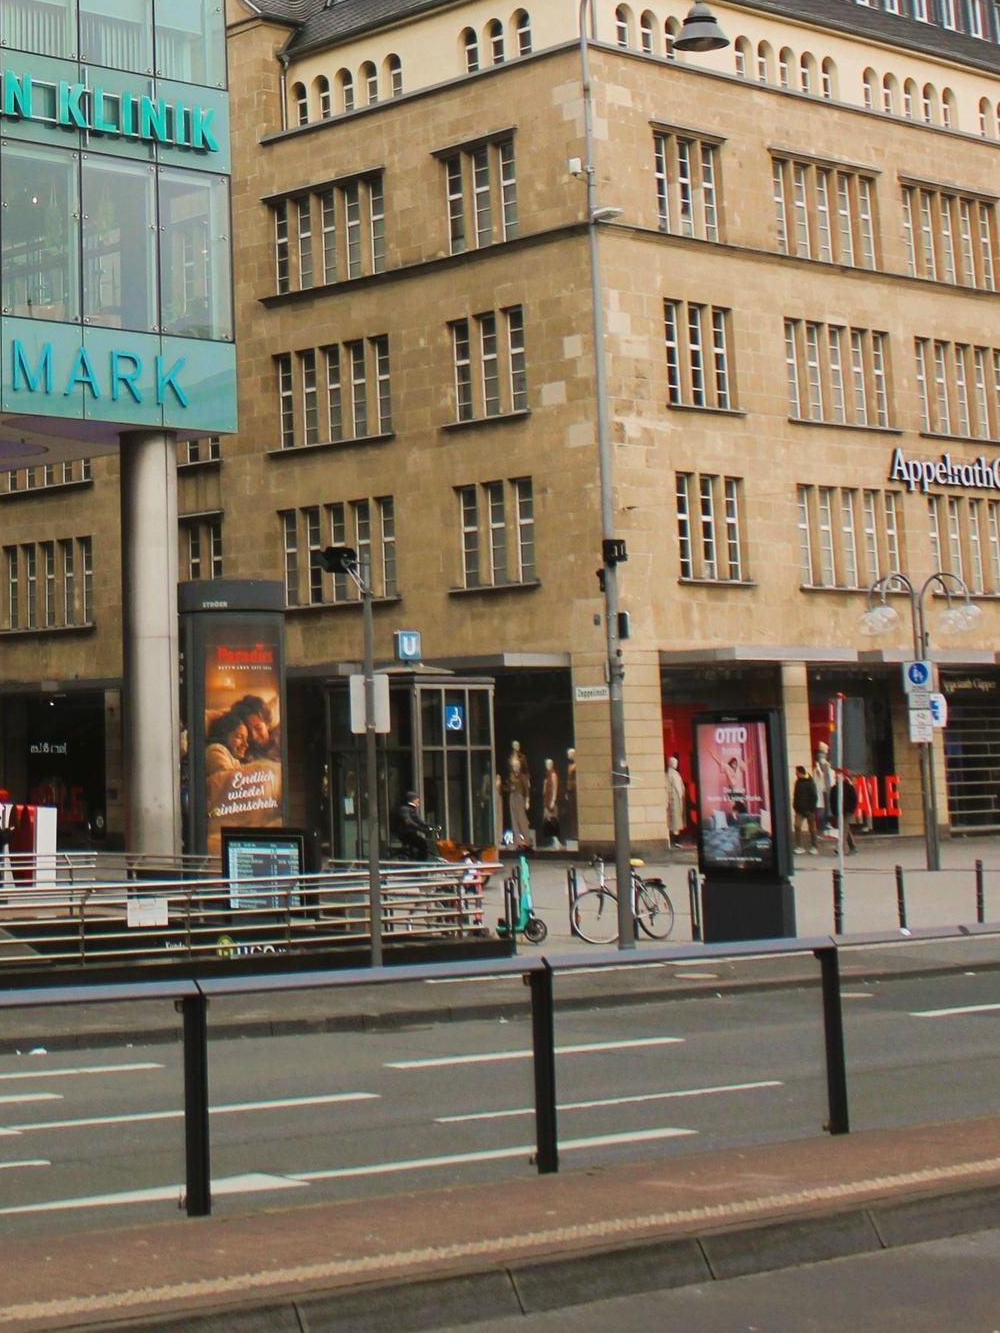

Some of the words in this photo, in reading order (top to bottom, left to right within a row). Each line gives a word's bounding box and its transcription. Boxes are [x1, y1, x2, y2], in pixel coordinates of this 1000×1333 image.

[56, 79, 220, 153] KLINIK
[403, 636, 416, 656] U
[715, 727, 747, 744] OTTO
[232, 770, 276, 789] Endlich
[227, 785, 265, 801] wieder
[853, 774, 903, 819] ALE
